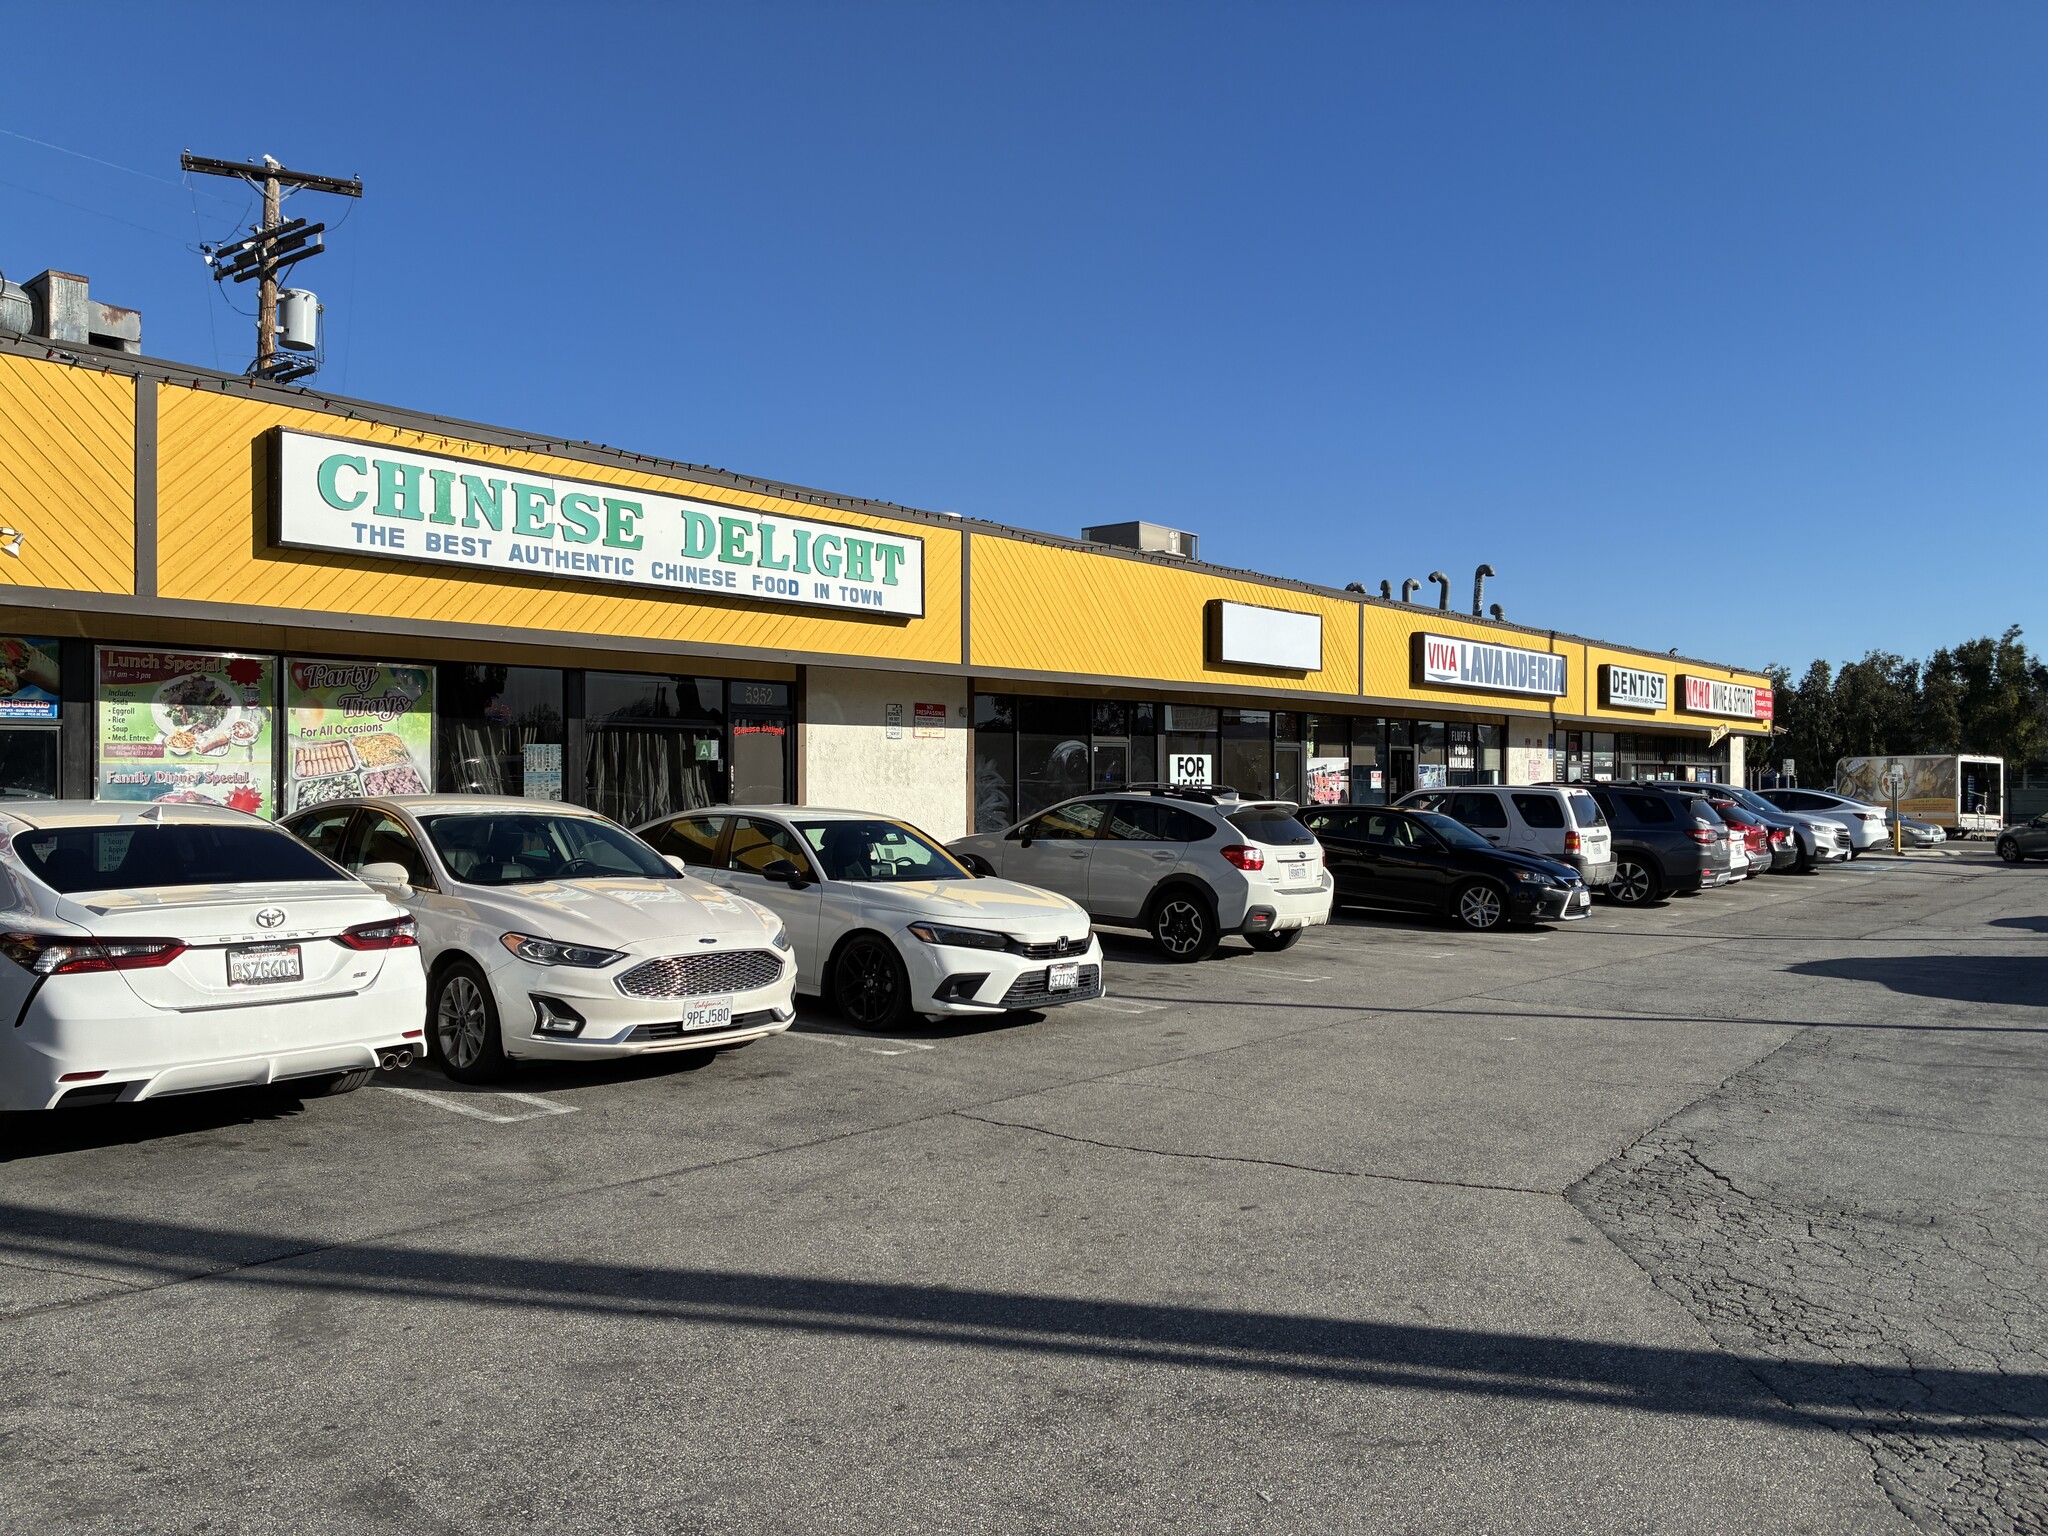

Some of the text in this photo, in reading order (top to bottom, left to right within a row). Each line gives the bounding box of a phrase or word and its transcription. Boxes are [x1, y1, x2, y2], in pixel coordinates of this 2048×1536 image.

[317, 453, 905, 586] CHINESE DELIGHT
[351, 522, 883, 606] THE BEST AUTHENTIC CHINESE FOOD IN TOWN
[108, 651, 221, 674] Lunch Special
[1428, 642, 1563, 692] VIVA LAVANDERIA
[304, 664, 379, 691] Party
[1613, 670, 1664, 699] DENTIST
[108, 689, 136, 697] Includes:
[745, 687, 773, 704] 5952
[1686, 679, 1753, 714] NOHO WINE & SPIRITS
[12, 700, 50, 708] Burrito
[112, 698, 128, 706] Soda
[337, 693, 412, 722] Trays
[112, 708, 135, 717] Eggroll
[112, 726, 128, 734] Soup
[300, 723, 383, 738] For All Occasions
[1451, 730, 1471, 742] FLUFF &
[129, 734, 150, 742] Entree
[700, 745, 709, 756] A
[1454, 744, 1468, 756] FOLD
[1177, 756, 1205, 777] FOR
[1448, 757, 1475, 769] AVAILABLE
[106, 770, 152, 786] Family
[154, 771, 202, 785] Dinner
[107, 838, 123, 846] Soup
[232, 959, 298, 981] 8SZG603
[694, 1000, 723, 1010] California
[686, 1007, 730, 1027] 9PEJ580
